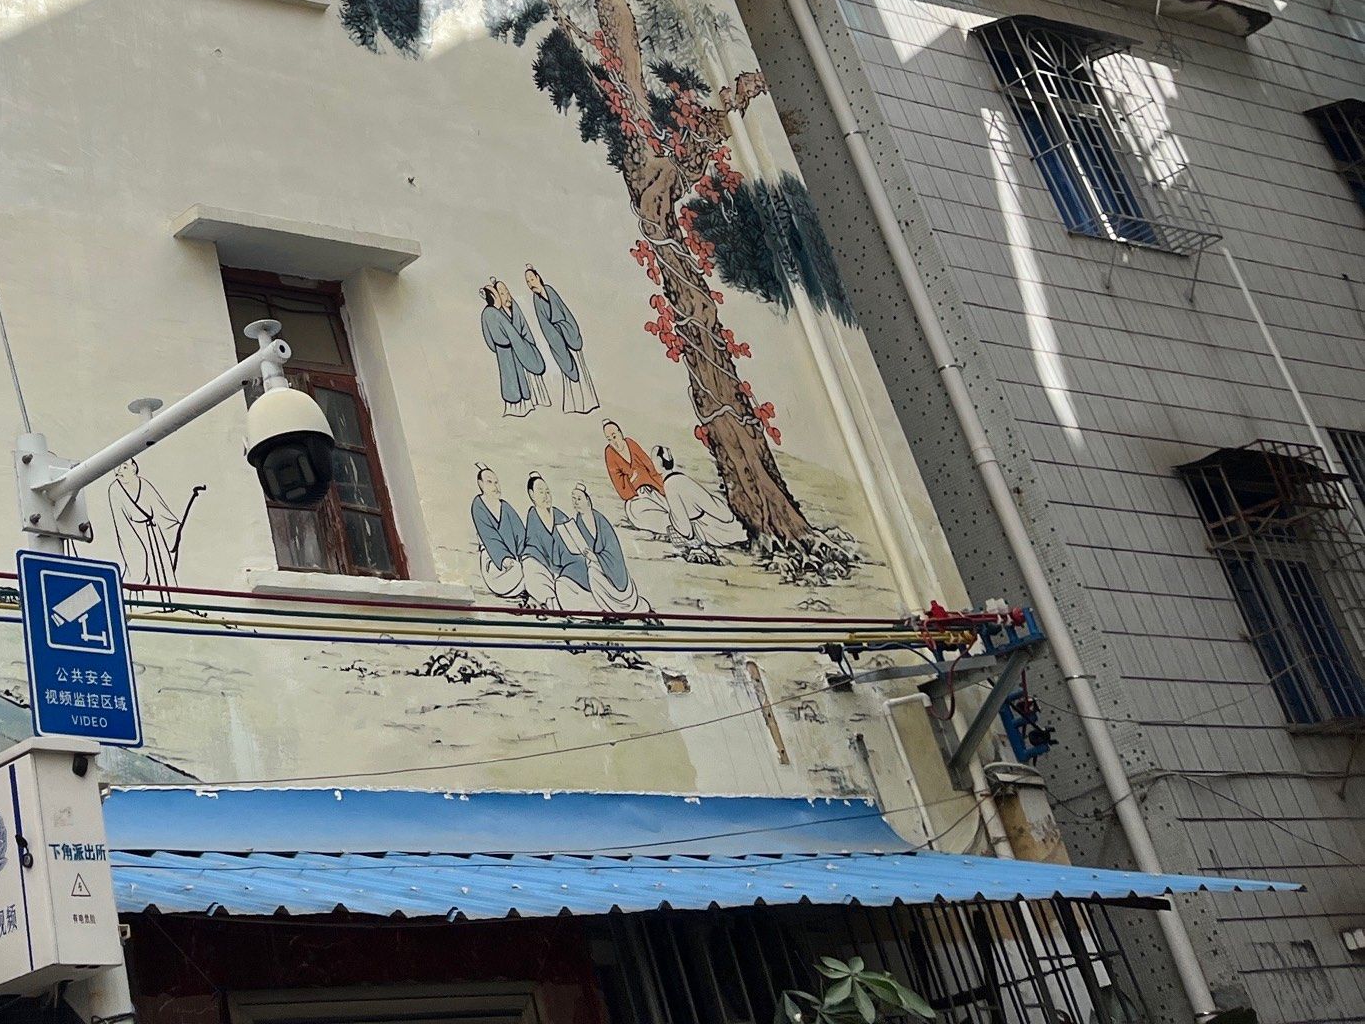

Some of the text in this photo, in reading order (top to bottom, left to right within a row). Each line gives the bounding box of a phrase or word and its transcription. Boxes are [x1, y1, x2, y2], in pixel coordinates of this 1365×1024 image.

[56, 666, 113, 687] 公共安全
[45, 688, 128, 712] 视频监控区域
[71, 714, 108, 728] VIDEO
[49, 843, 106, 861] 下角派出所
